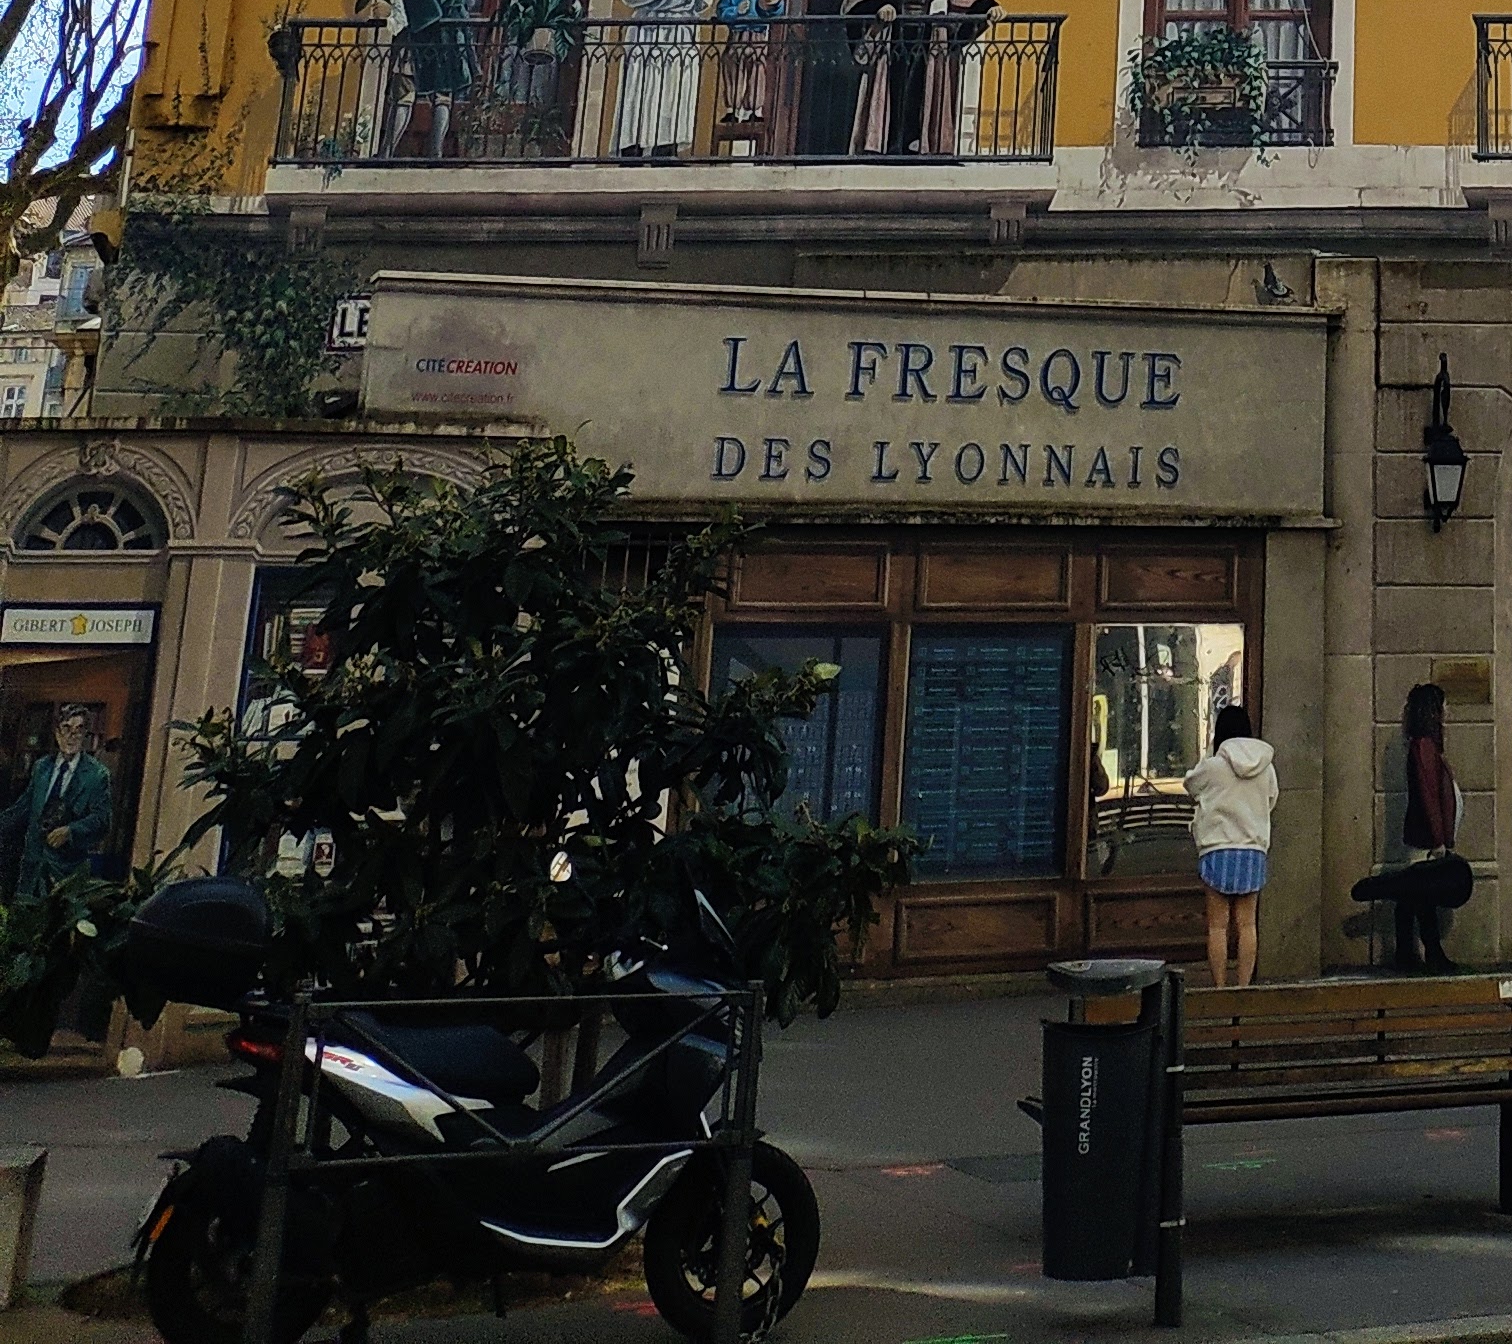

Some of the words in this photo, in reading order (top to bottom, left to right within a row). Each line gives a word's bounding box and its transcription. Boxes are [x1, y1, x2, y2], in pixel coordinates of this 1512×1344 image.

[721, 337, 814, 398] LA
[844, 342, 1183, 414] FRESQUE
[712, 437, 834, 483] DES
[870, 441, 1183, 489] LYONNAIS
[13, 617, 67, 632] GIBERT
[88, 617, 143, 633] JOSEPH
[1077, 1056, 1093, 1154] GRANDLYON
